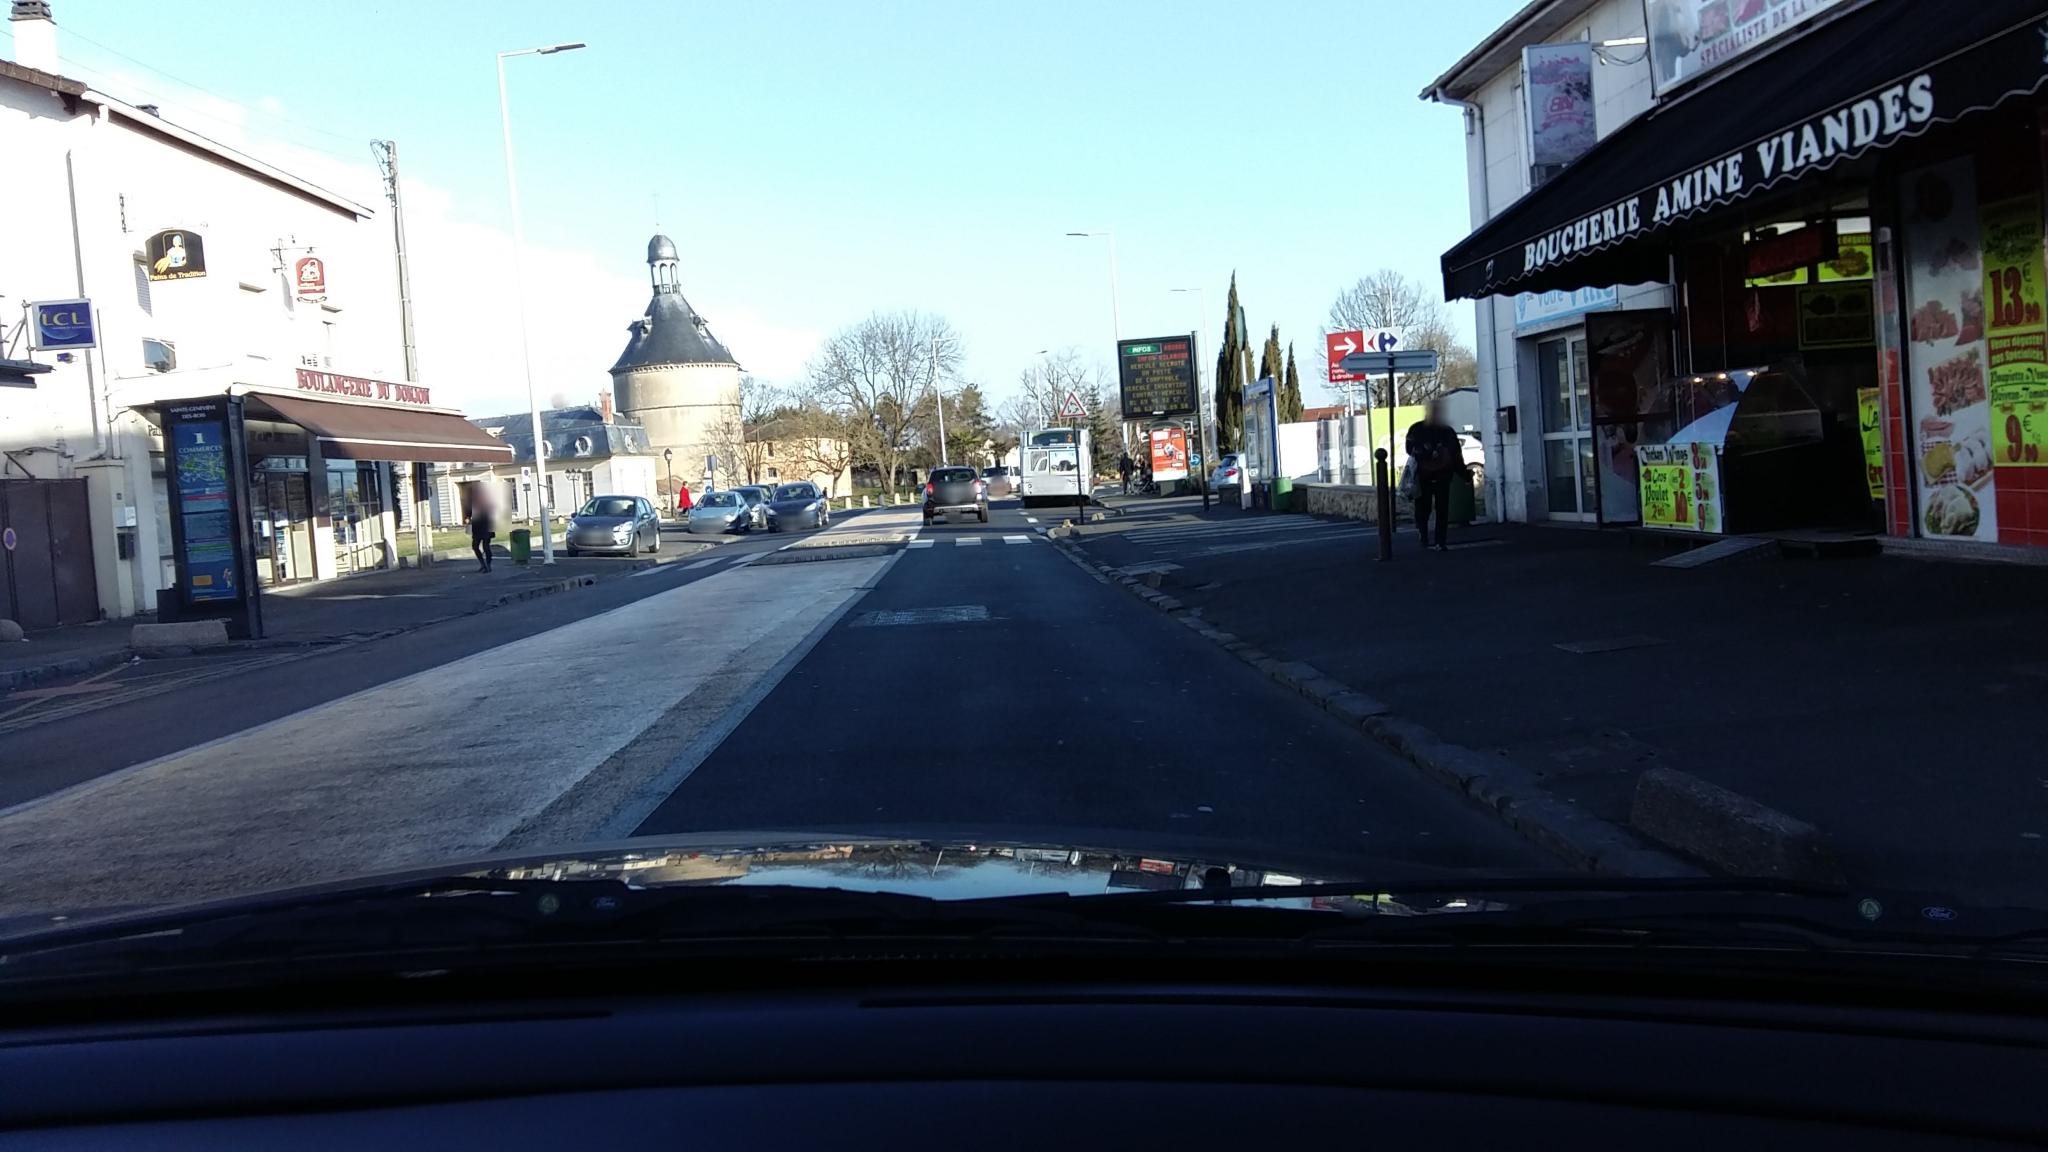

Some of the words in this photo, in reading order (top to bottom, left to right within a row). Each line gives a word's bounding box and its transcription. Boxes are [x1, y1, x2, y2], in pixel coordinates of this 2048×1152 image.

[1772, 9, 1787, 28] DE
[1523, 197, 1641, 272] BOUCHERIE
[1652, 152, 1744, 222] AMINE
[1757, 73, 1934, 179] VIANDES
[1989, 266, 2024, 328] 13
[42, 312, 86, 326] LCL
[296, 368, 372, 398] BOULANGERIE
[377, 382, 390, 400] DU
[395, 385, 430, 405] DONJON
[178, 445, 223, 454] COMMERCES
[2006, 415, 2022, 462] 9
[2023, 414, 2032, 432] €
